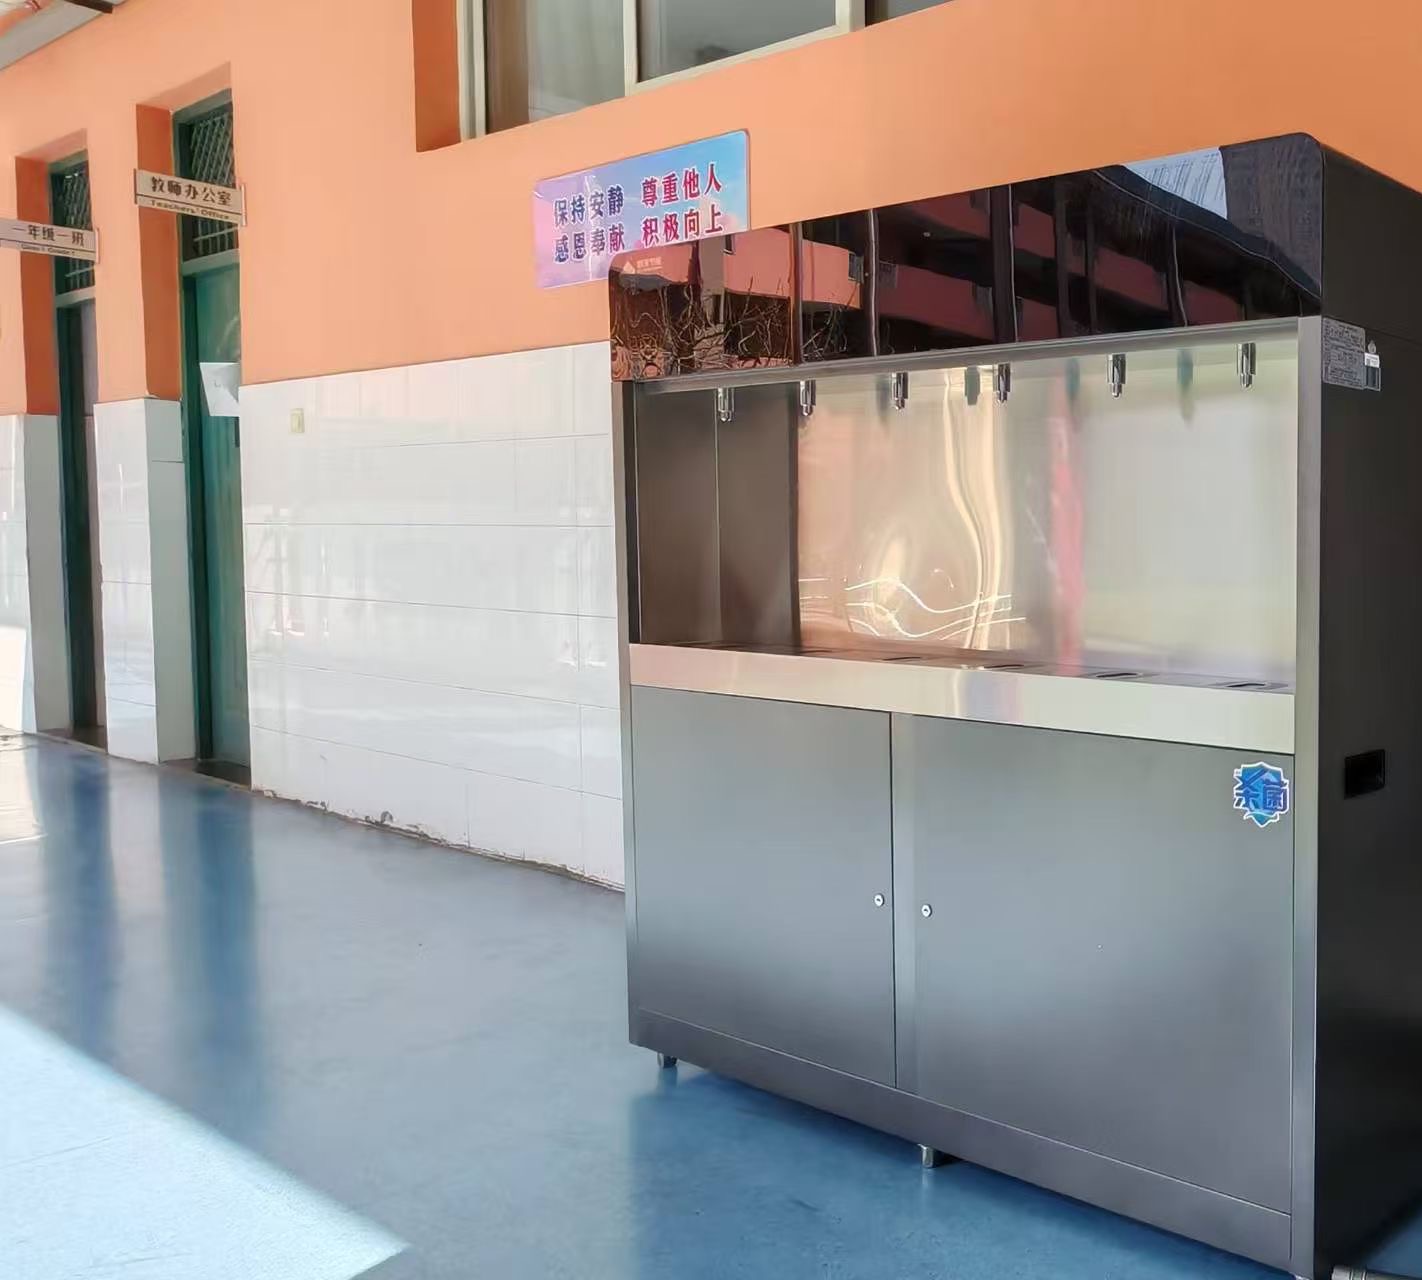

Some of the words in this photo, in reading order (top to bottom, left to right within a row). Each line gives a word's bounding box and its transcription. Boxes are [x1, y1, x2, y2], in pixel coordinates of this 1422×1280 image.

[151, 176, 231, 206] 教师办公室
[554, 184, 624, 227] 保持安静
[641, 163, 721, 207] 尊重他人
[11, 224, 84, 247] 一年级一班
[554, 223, 625, 263] 感恩奉献
[642, 205, 722, 245] 积极向上
